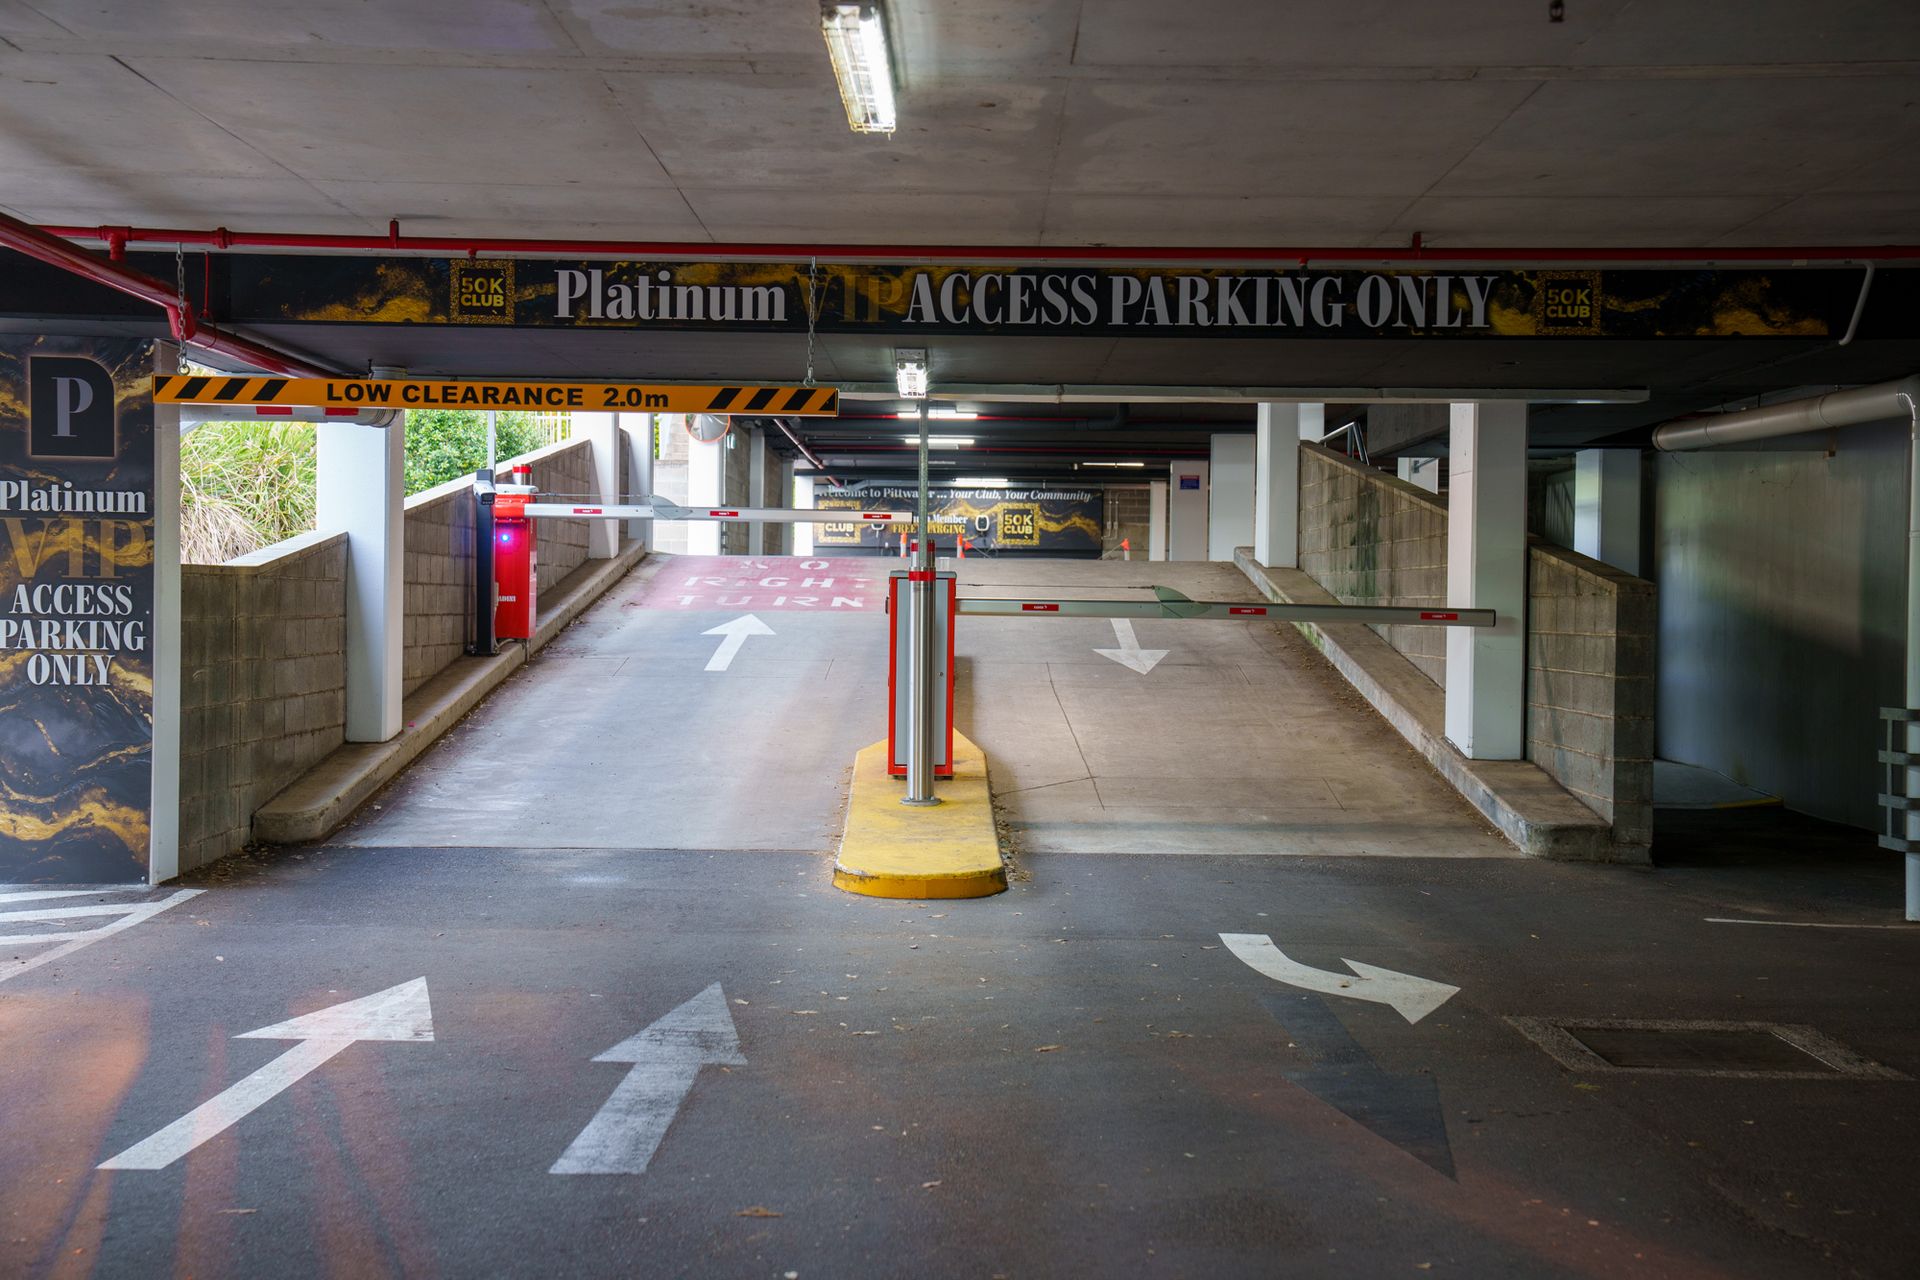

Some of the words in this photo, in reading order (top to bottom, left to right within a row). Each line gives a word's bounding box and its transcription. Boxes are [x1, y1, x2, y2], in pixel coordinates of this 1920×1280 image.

[461, 278, 504, 294] 50K
[460, 294, 504, 307] CLUB
[554, 269, 788, 322] Platinum
[800, 272, 903, 323] VIP
[902, 273, 1098, 326] ACCESS
[1107, 274, 1347, 328] PARKING
[1356, 275, 1499, 329] ONLY
[1546, 288, 1591, 305] 50K
[1546, 304, 1591, 318] CLUB
[327, 383, 392, 402] LOW
[402, 385, 584, 407] CLEARANCE
[603, 387, 669, 408] 2.0m
[51, 376, 94, 437] P
[0, 480, 147, 513] Platinum
[870, 488, 881, 498] to
[950, 489, 975, 499] Your
[1005, 490, 1030, 500] Your
[932, 514, 968, 524] Member
[1004, 514, 1033, 526] 50K
[825, 522, 855, 533] CLUB
[892, 524, 917, 534] FREE
[1004, 525, 1033, 535] CLUB
[0, 517, 147, 579] VIP
[9, 583, 133, 616] ACCESS
[678, 595, 864, 608] TURN
[0, 619, 146, 651] PARKING
[27, 653, 116, 686] ONLY
